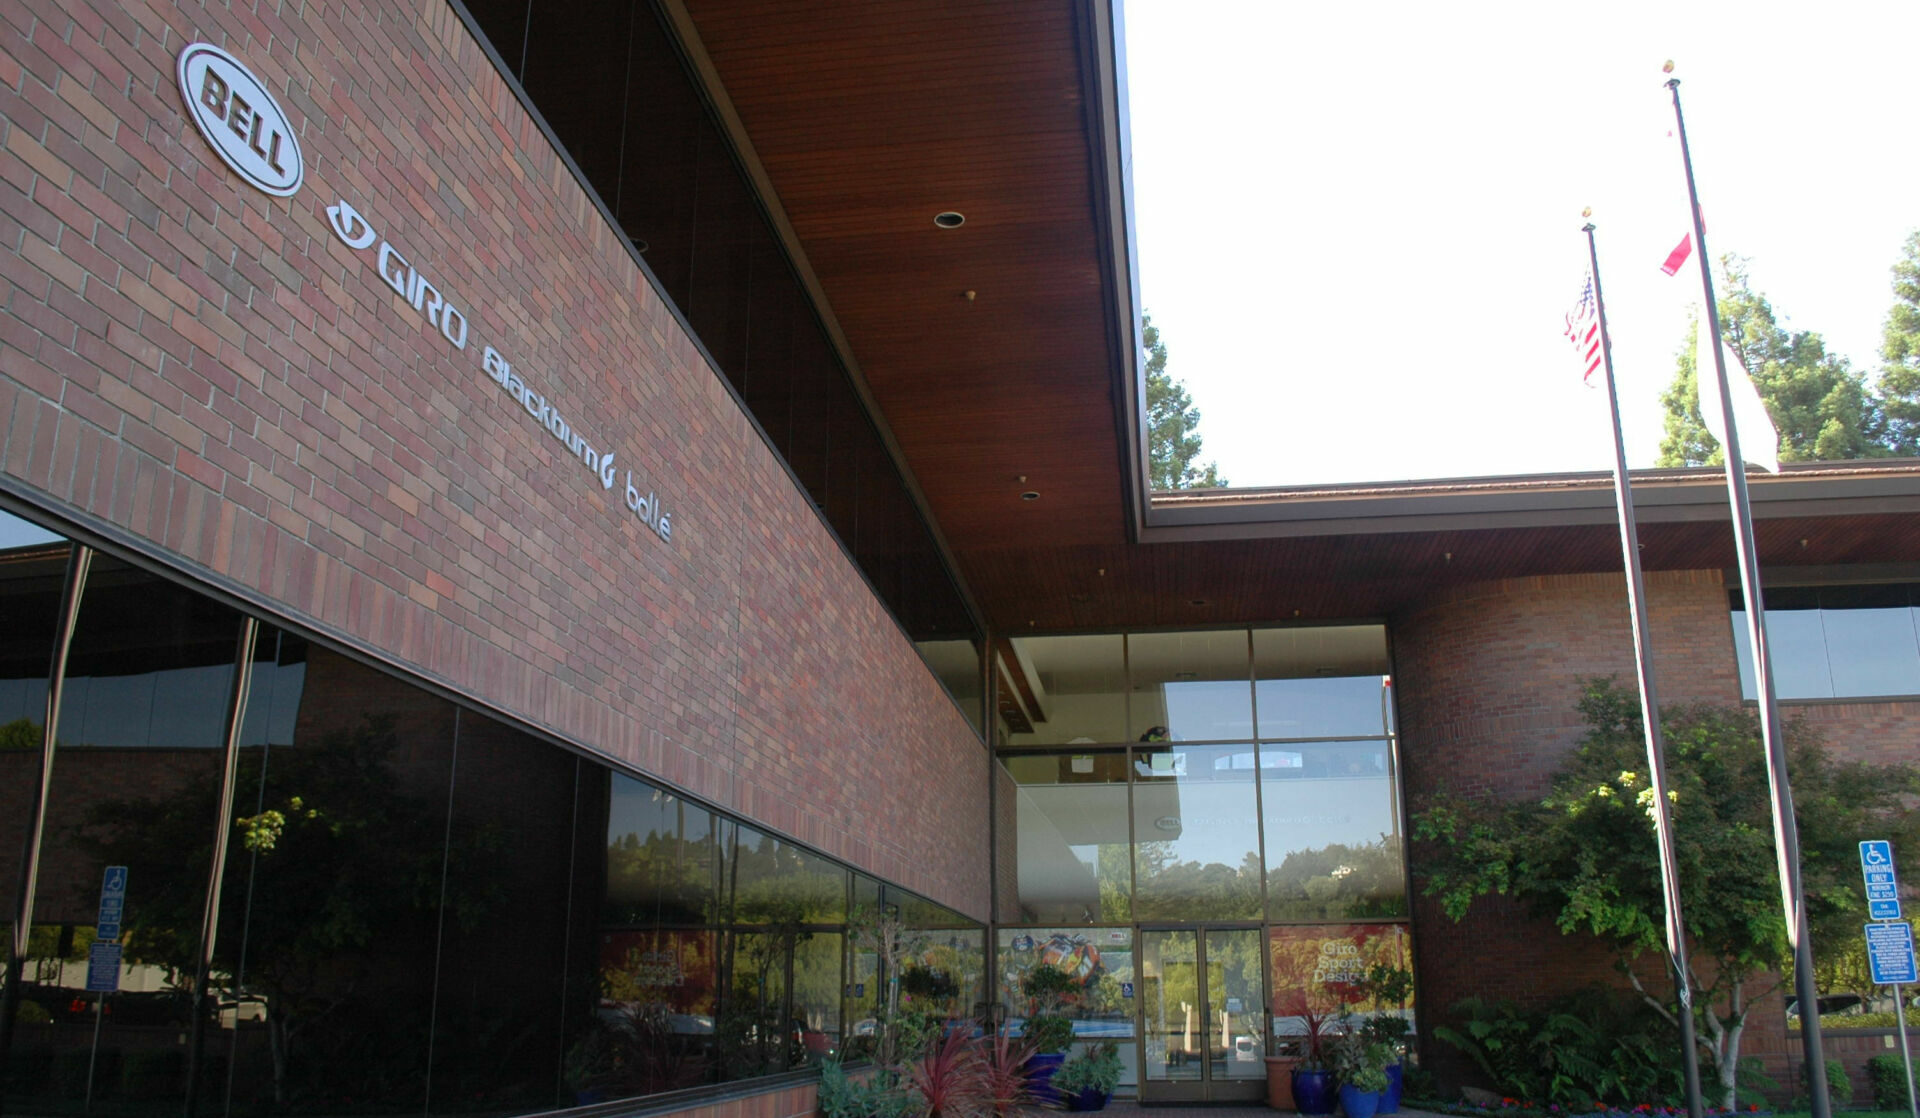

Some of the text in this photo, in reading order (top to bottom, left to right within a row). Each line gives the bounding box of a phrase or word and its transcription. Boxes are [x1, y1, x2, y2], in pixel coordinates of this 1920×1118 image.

[201, 64, 285, 178] BELL
[379, 240, 468, 350] GIRO
[482, 346, 599, 473] Blackburn
[626, 470, 671, 543] bollé
[1864, 864, 1891, 873] PARKING
[1871, 873, 1887, 882] ONLY
[1318, 955, 1364, 972] Sport
[1323, 942, 1357, 955] Giro
